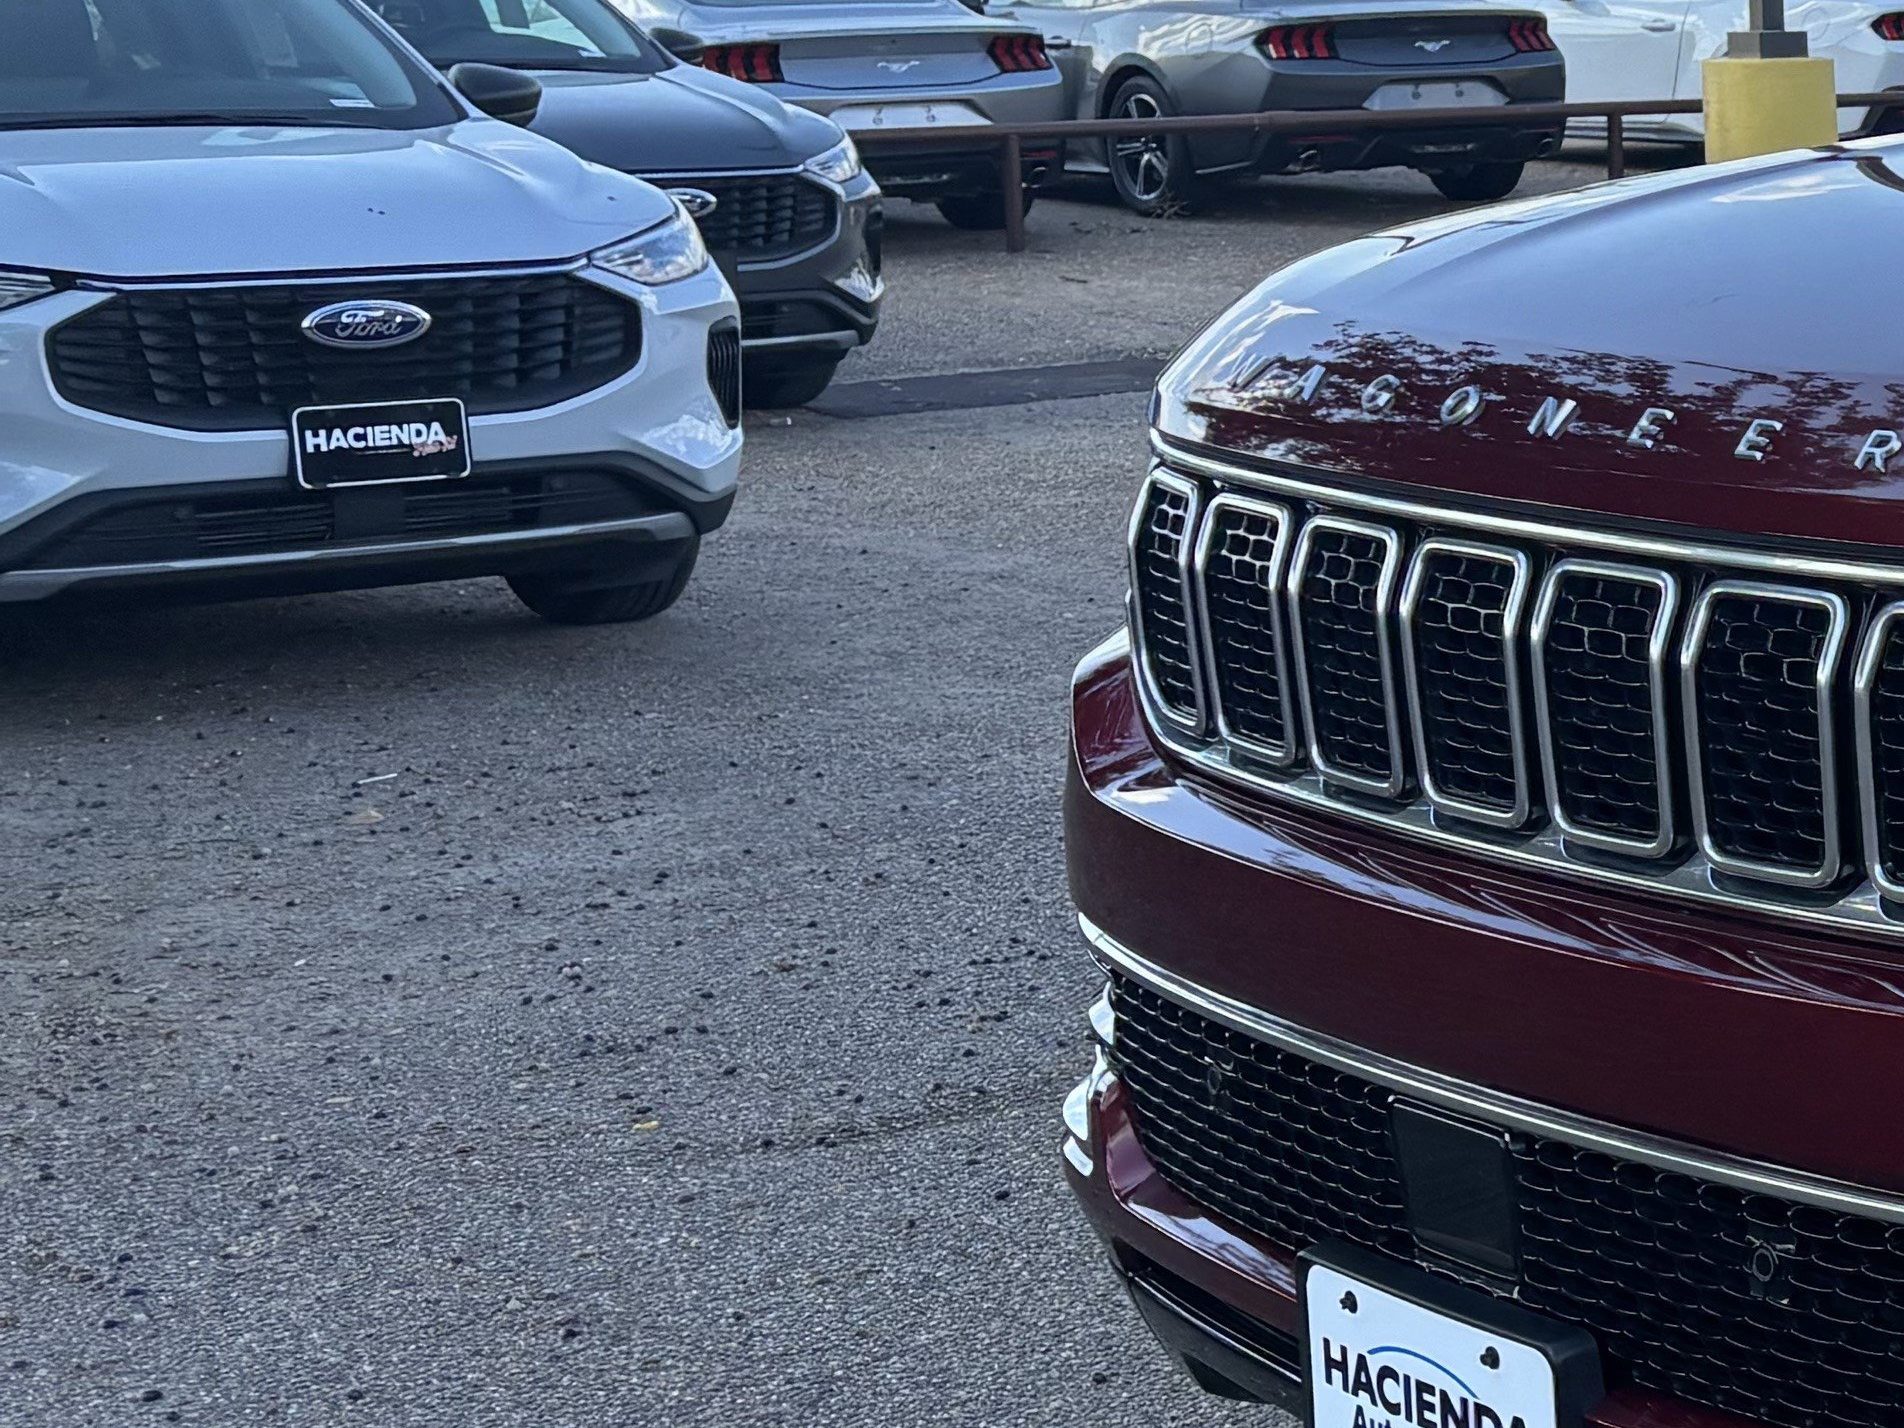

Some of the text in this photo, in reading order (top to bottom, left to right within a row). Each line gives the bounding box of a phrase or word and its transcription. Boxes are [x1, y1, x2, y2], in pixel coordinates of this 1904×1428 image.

[334, 309, 402, 337] Ford
[1226, 352, 1903, 474] WAGONEER
[304, 421, 447, 454] HACIENDA
